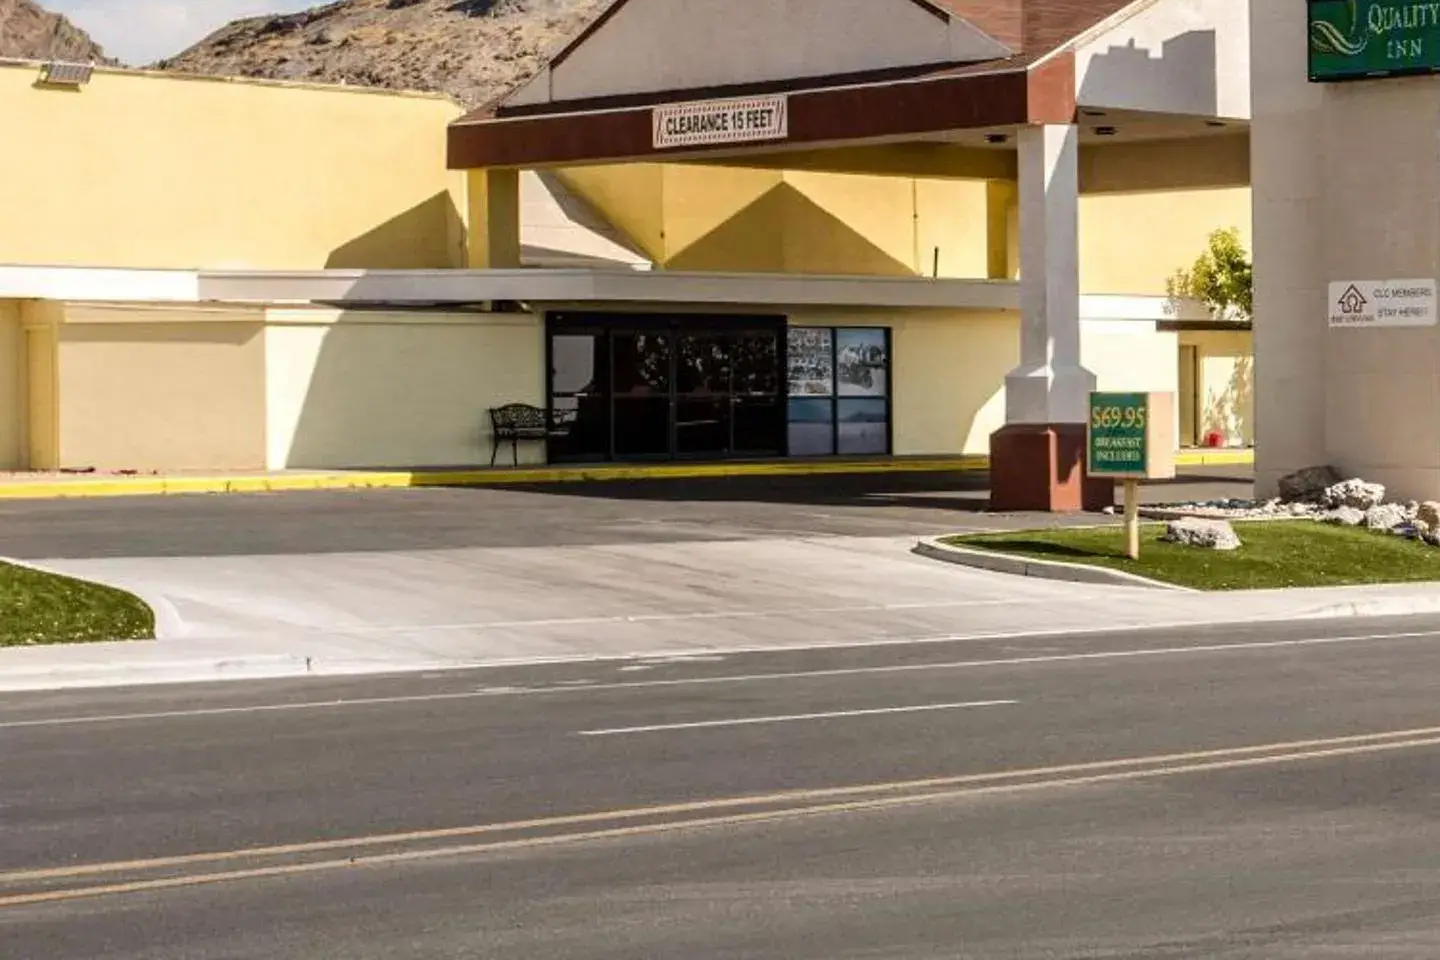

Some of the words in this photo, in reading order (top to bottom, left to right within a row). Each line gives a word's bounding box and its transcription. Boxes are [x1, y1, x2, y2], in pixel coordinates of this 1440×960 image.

[1368, 3, 1440, 34] QUALITY
[1387, 38, 1423, 59] INN
[665, 113, 729, 136] CLEARANCE
[732, 110, 744, 130] 15
[747, 108, 774, 129] FEET
[1092, 406, 1145, 429] $69.95
